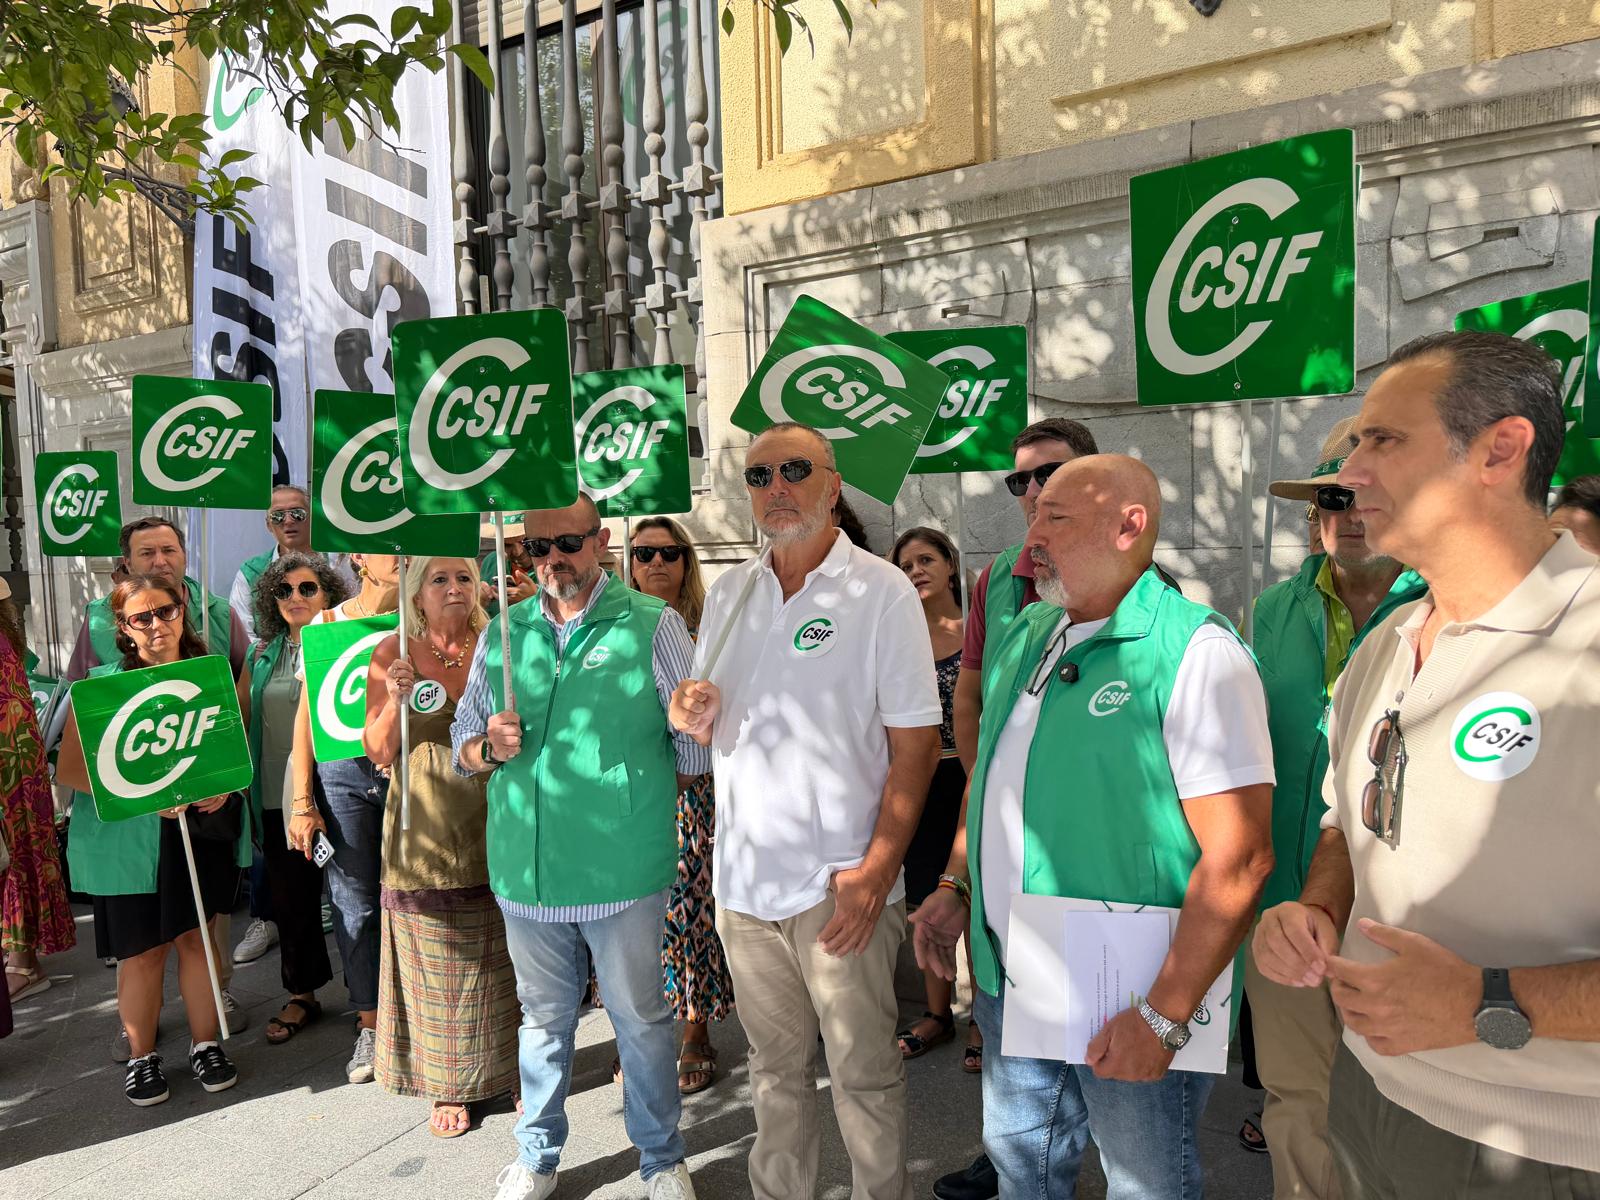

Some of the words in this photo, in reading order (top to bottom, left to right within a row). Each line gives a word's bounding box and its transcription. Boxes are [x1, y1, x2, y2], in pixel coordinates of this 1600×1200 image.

[1178, 231, 1324, 313] CSIF
[436, 384, 550, 440] CSIF
[796, 366, 912, 429] CSIF
[939, 378, 1010, 418] SIF
[163, 424, 256, 461] CSIF
[584, 420, 670, 463] CSIF
[54, 489, 108, 517] CSIF
[802, 627, 834, 642] CSIF
[419, 687, 439, 704] CSIF
[1099, 691, 1131, 705] CSIF
[122, 704, 221, 762] CSIF
[1472, 722, 1533, 753] CSIF
